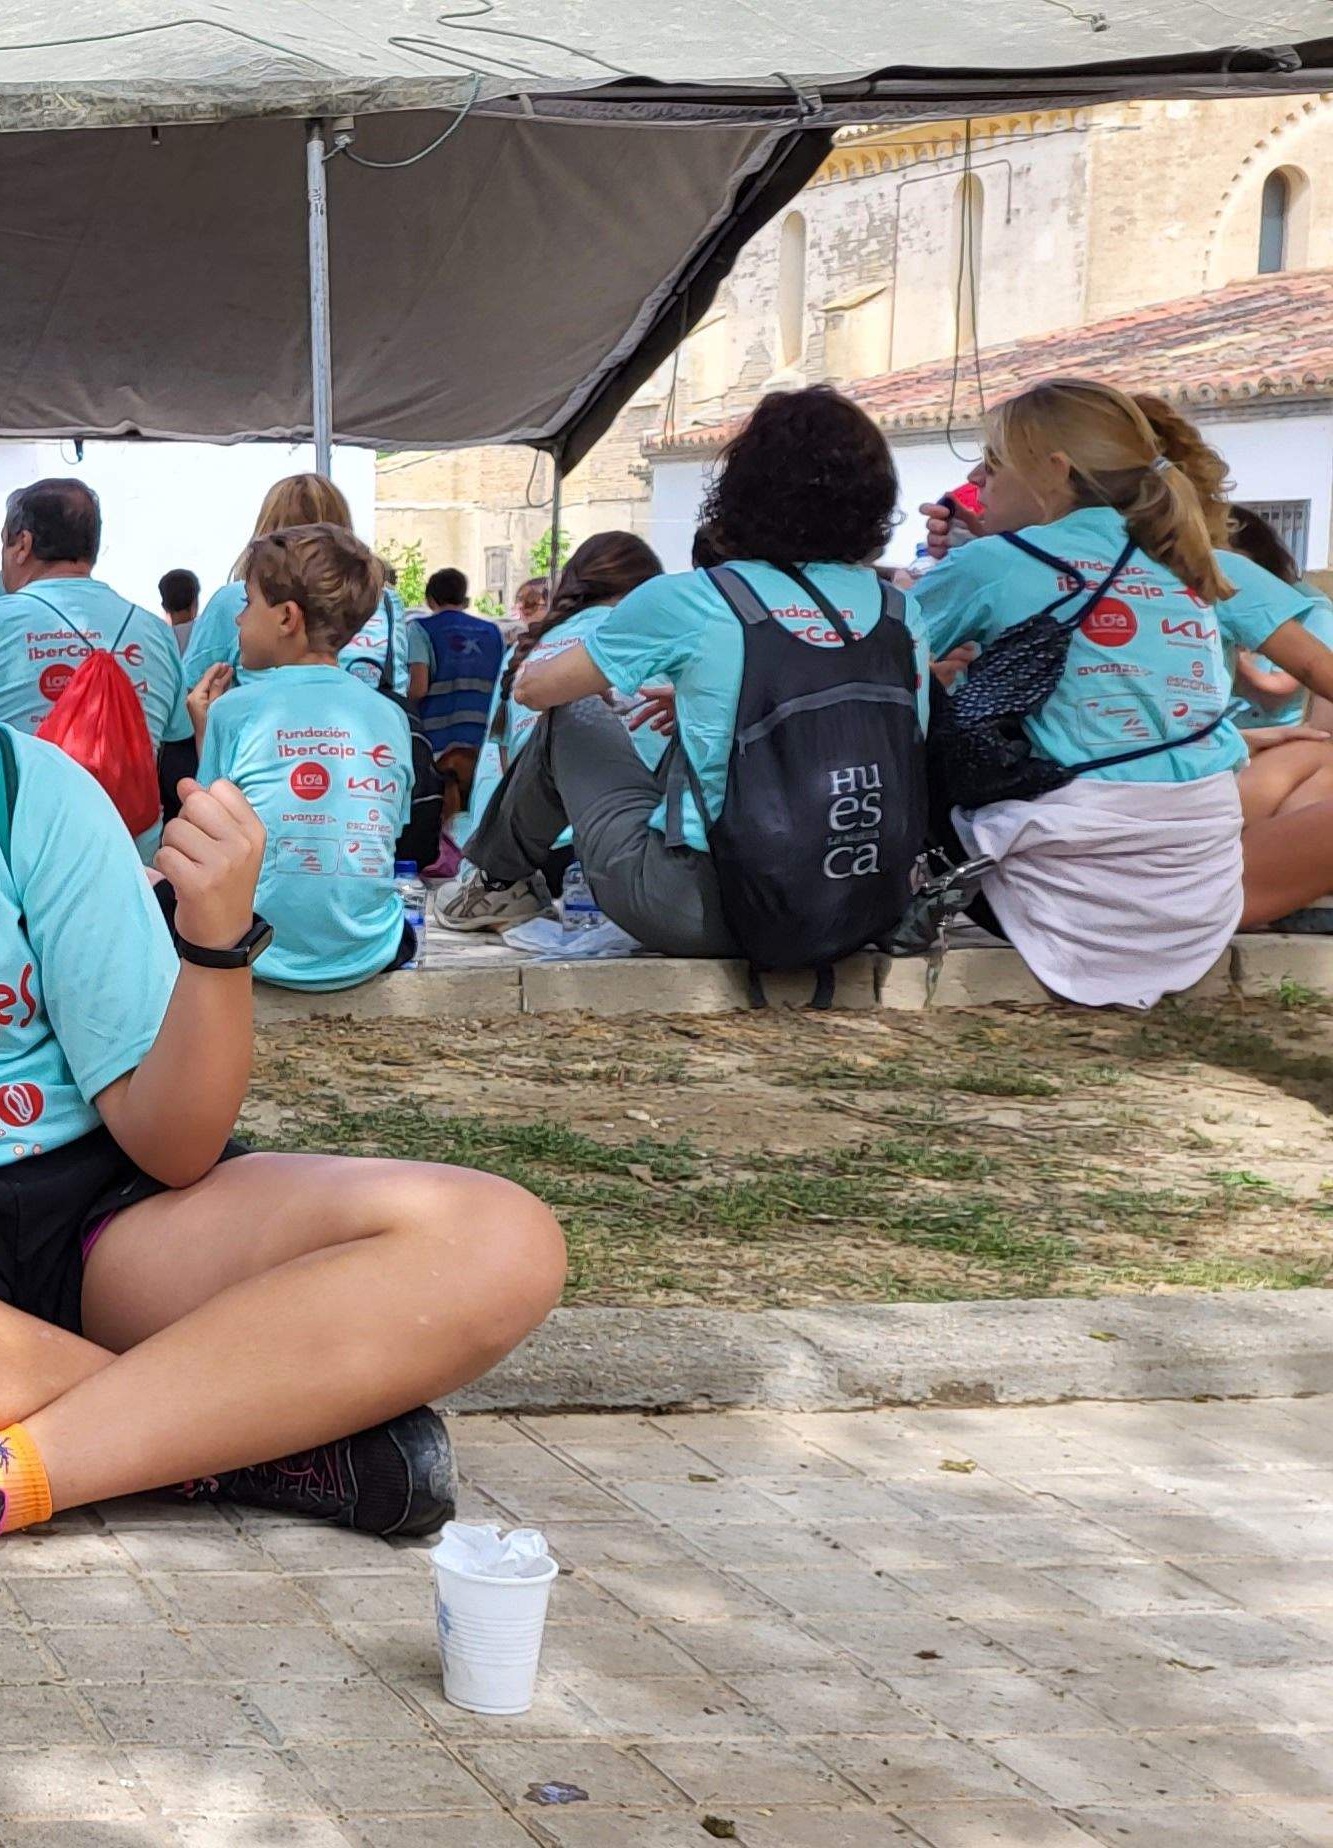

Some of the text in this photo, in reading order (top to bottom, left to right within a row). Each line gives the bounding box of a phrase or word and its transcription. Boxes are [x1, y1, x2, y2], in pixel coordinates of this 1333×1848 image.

[1057, 574, 1165, 600] ibeCaja
[26, 629, 102, 644] Fundacón
[276, 727, 351, 741] Fundación
